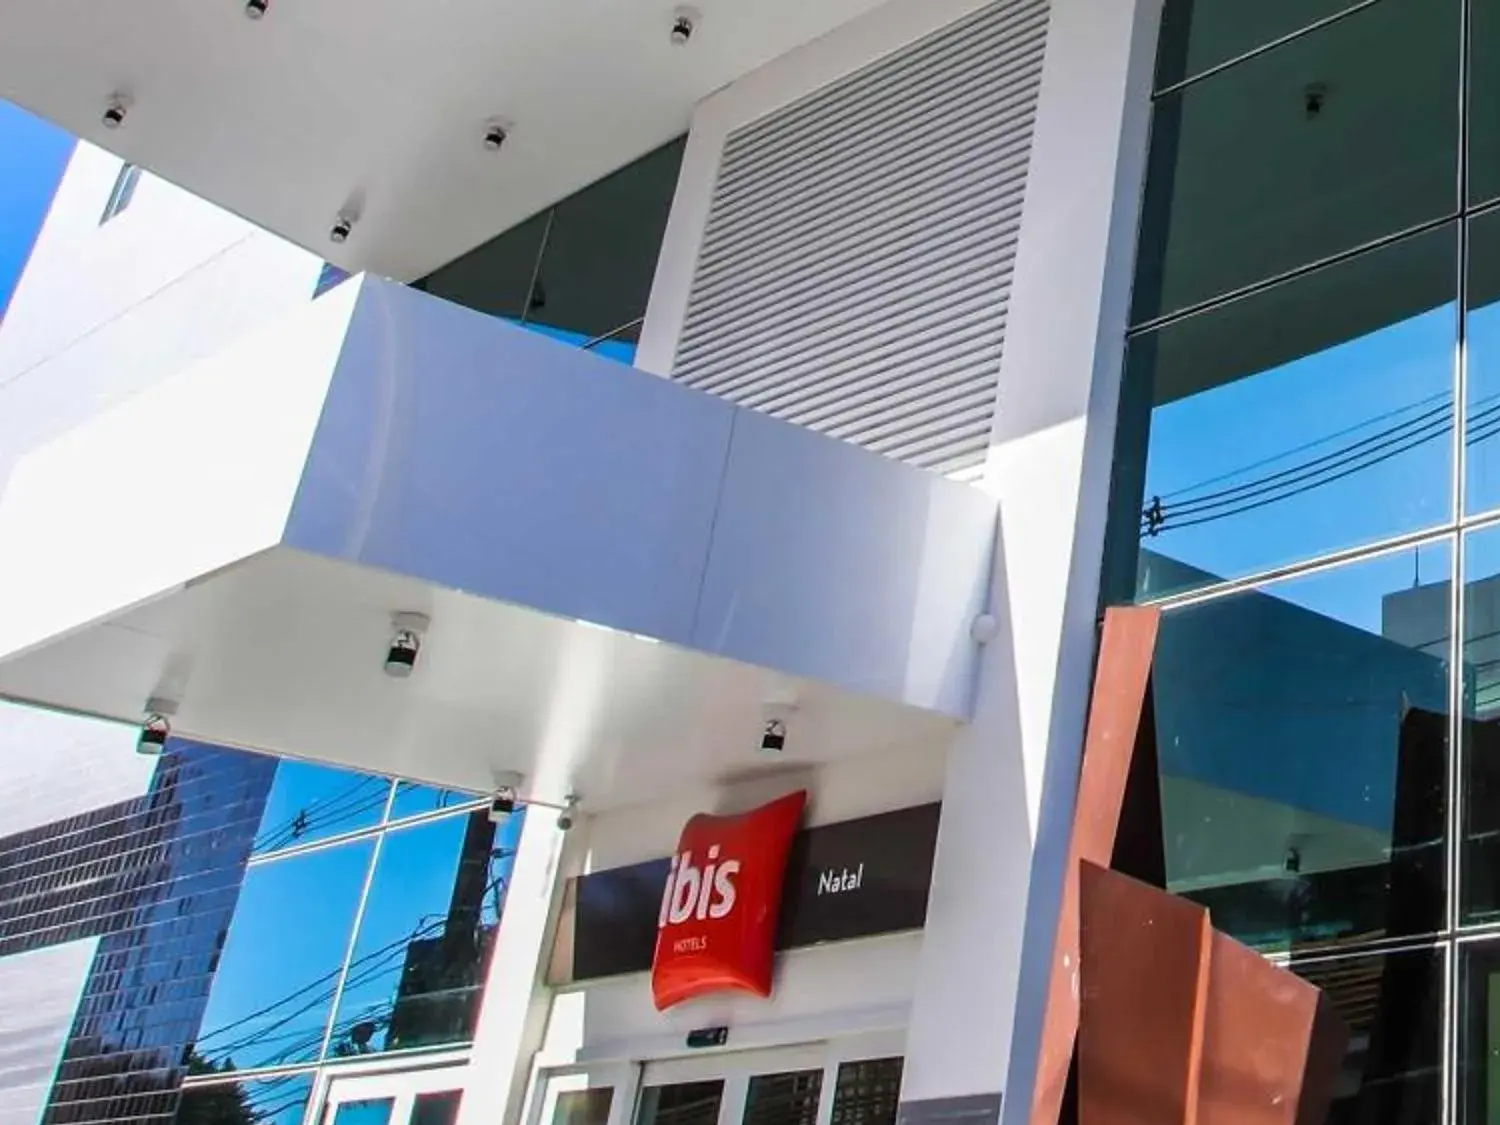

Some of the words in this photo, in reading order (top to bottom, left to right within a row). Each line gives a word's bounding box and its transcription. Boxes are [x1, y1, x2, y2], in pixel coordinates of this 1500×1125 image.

[659, 844, 740, 928] ibis
[817, 863, 864, 895] Natal
[673, 936, 707, 953] HOTELS
